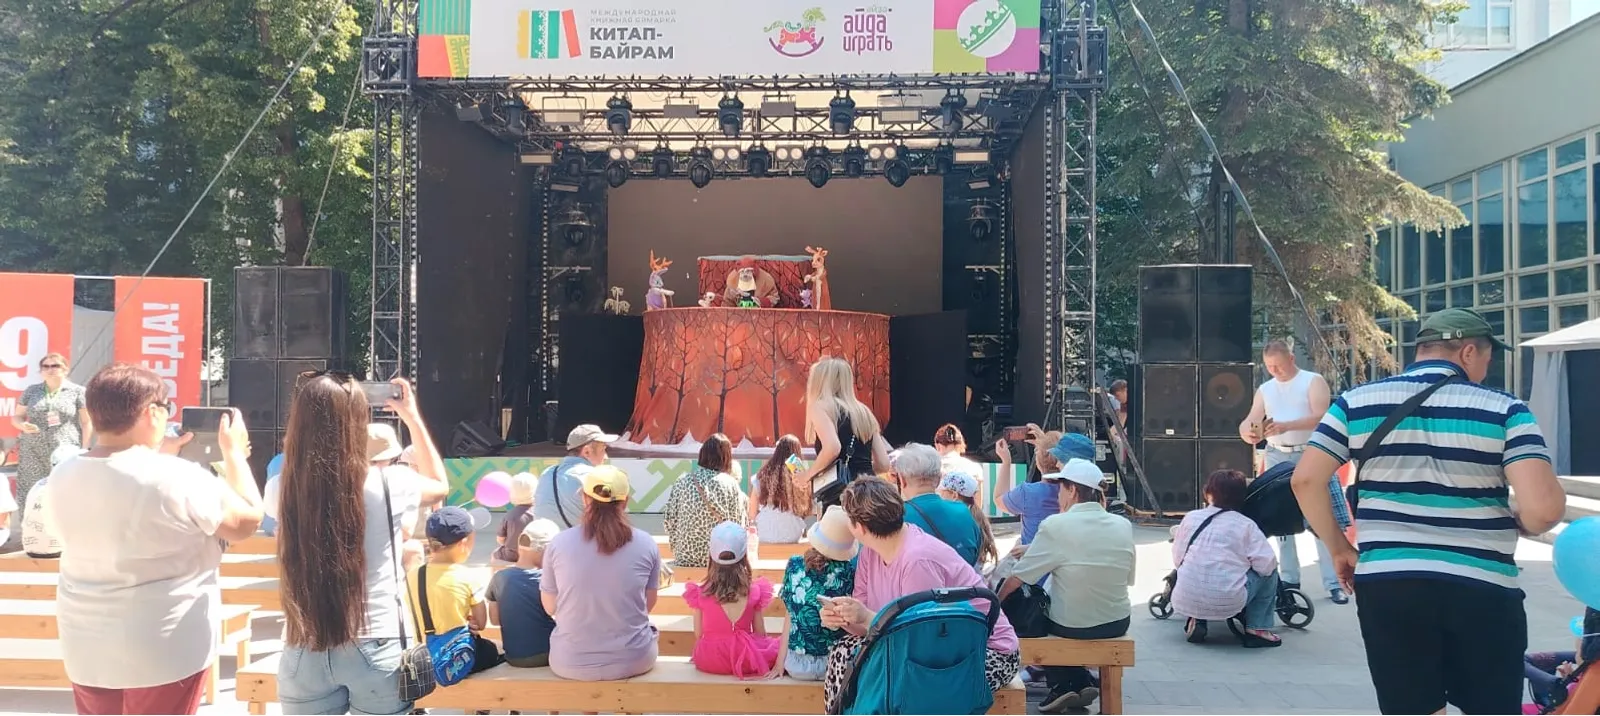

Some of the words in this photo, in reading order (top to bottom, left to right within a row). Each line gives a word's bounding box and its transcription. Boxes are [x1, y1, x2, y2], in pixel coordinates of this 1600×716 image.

[590, 9, 677, 17] МЕЖДУНАРОДНАЯ
[590, 27, 663, 41] КИТАП-
[590, 42, 674, 59] БАЙРАМ
[843, 34, 893, 56] играть
[0, 316, 49, 392] 9
[141, 302, 185, 419] ЕДА!
